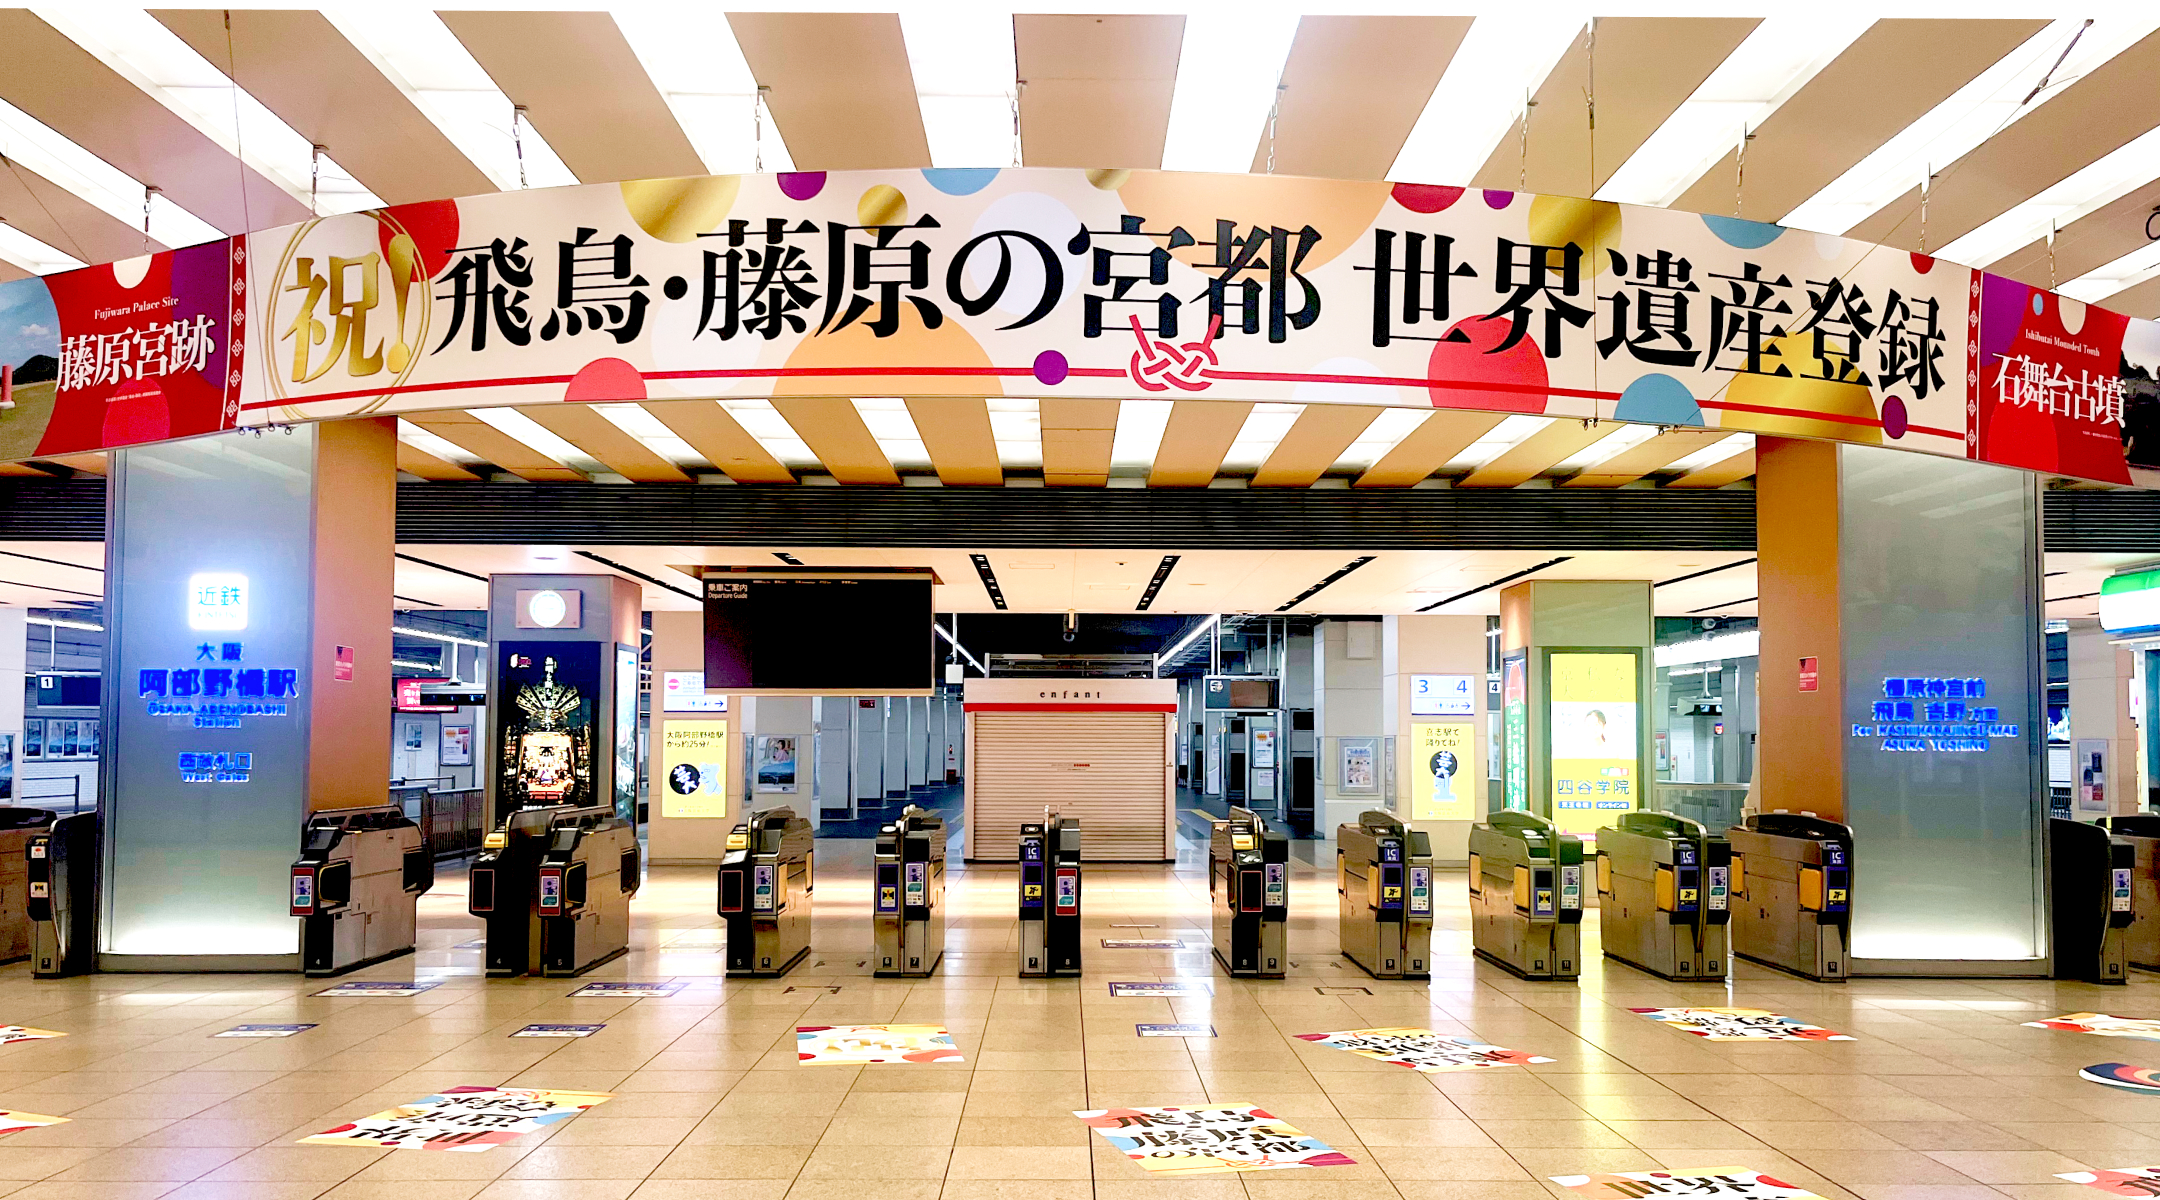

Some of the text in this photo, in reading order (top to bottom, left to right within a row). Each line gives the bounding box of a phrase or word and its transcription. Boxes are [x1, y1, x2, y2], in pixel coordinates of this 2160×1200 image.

[94, 296, 179, 321] Fujiwara Palace Site
[431, 213, 1947, 400] 飛鳥・藤原の宮都 世界遺産登録
[2025, 329, 2100, 357] Ishibutai Mounded Tomb
[54, 314, 216, 393] 藤原宮跡
[1991, 353, 2127, 428] 石舞台古墳
[707, 583, 748, 592] 乗車ご案内
[197, 585, 241, 606] 近鉄
[707, 592, 733, 600] Departure
[196, 641, 245, 662] 大阪
[138, 666, 300, 699] 阿部野橋駅
[1418, 679, 1468, 694] 3 4
[1491, 683, 1498, 692] 4
[1039, 690, 1101, 699] enfant
[1871, 700, 1915, 722] 飛鳥
[192, 716, 241, 729] Station
[666, 730, 724, 739] 大阪阿部野橋駅
[1851, 723, 1873, 737] For
[1880, 738, 1991, 752] ASUKA YOSHINO
[178, 751, 253, 770] 西改札口
[181, 771, 212, 783] West
[1558, 779, 1630, 795] 四谷学院
[1027, 847, 1037, 855] IC
[1387, 848, 1397, 857] IC
[1682, 851, 1692, 859] IC
[1831, 851, 1842, 860] IC
